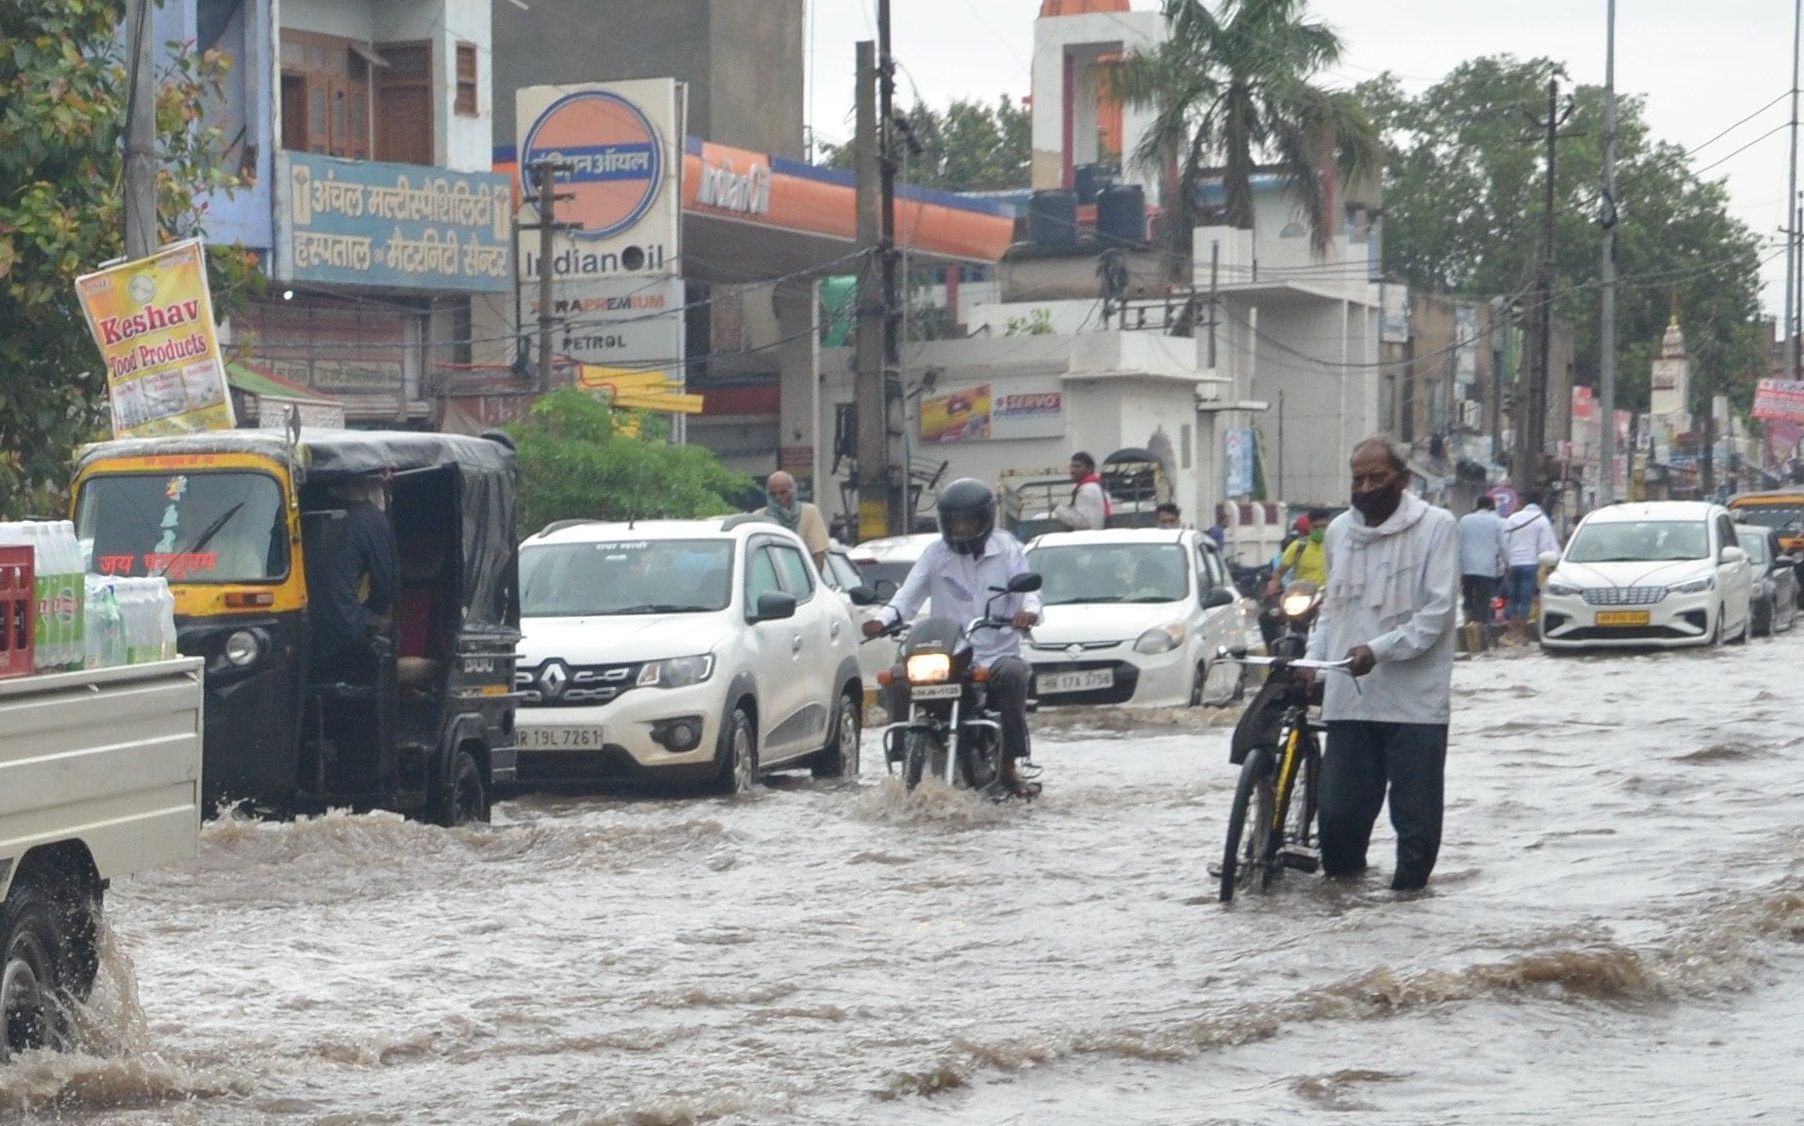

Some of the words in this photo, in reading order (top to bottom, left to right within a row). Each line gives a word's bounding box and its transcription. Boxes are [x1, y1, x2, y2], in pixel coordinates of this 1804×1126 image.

[311, 169, 364, 217] अंचल
[530, 294, 666, 315] XRAPREMIUM
[100, 299, 200, 345] Keshav
[139, 334, 207, 368] Products
[562, 335, 627, 350] PETROL
[100, 554, 135, 576] जय
[534, 730, 558, 746] 19L
[562, 729, 599, 746] 7261
